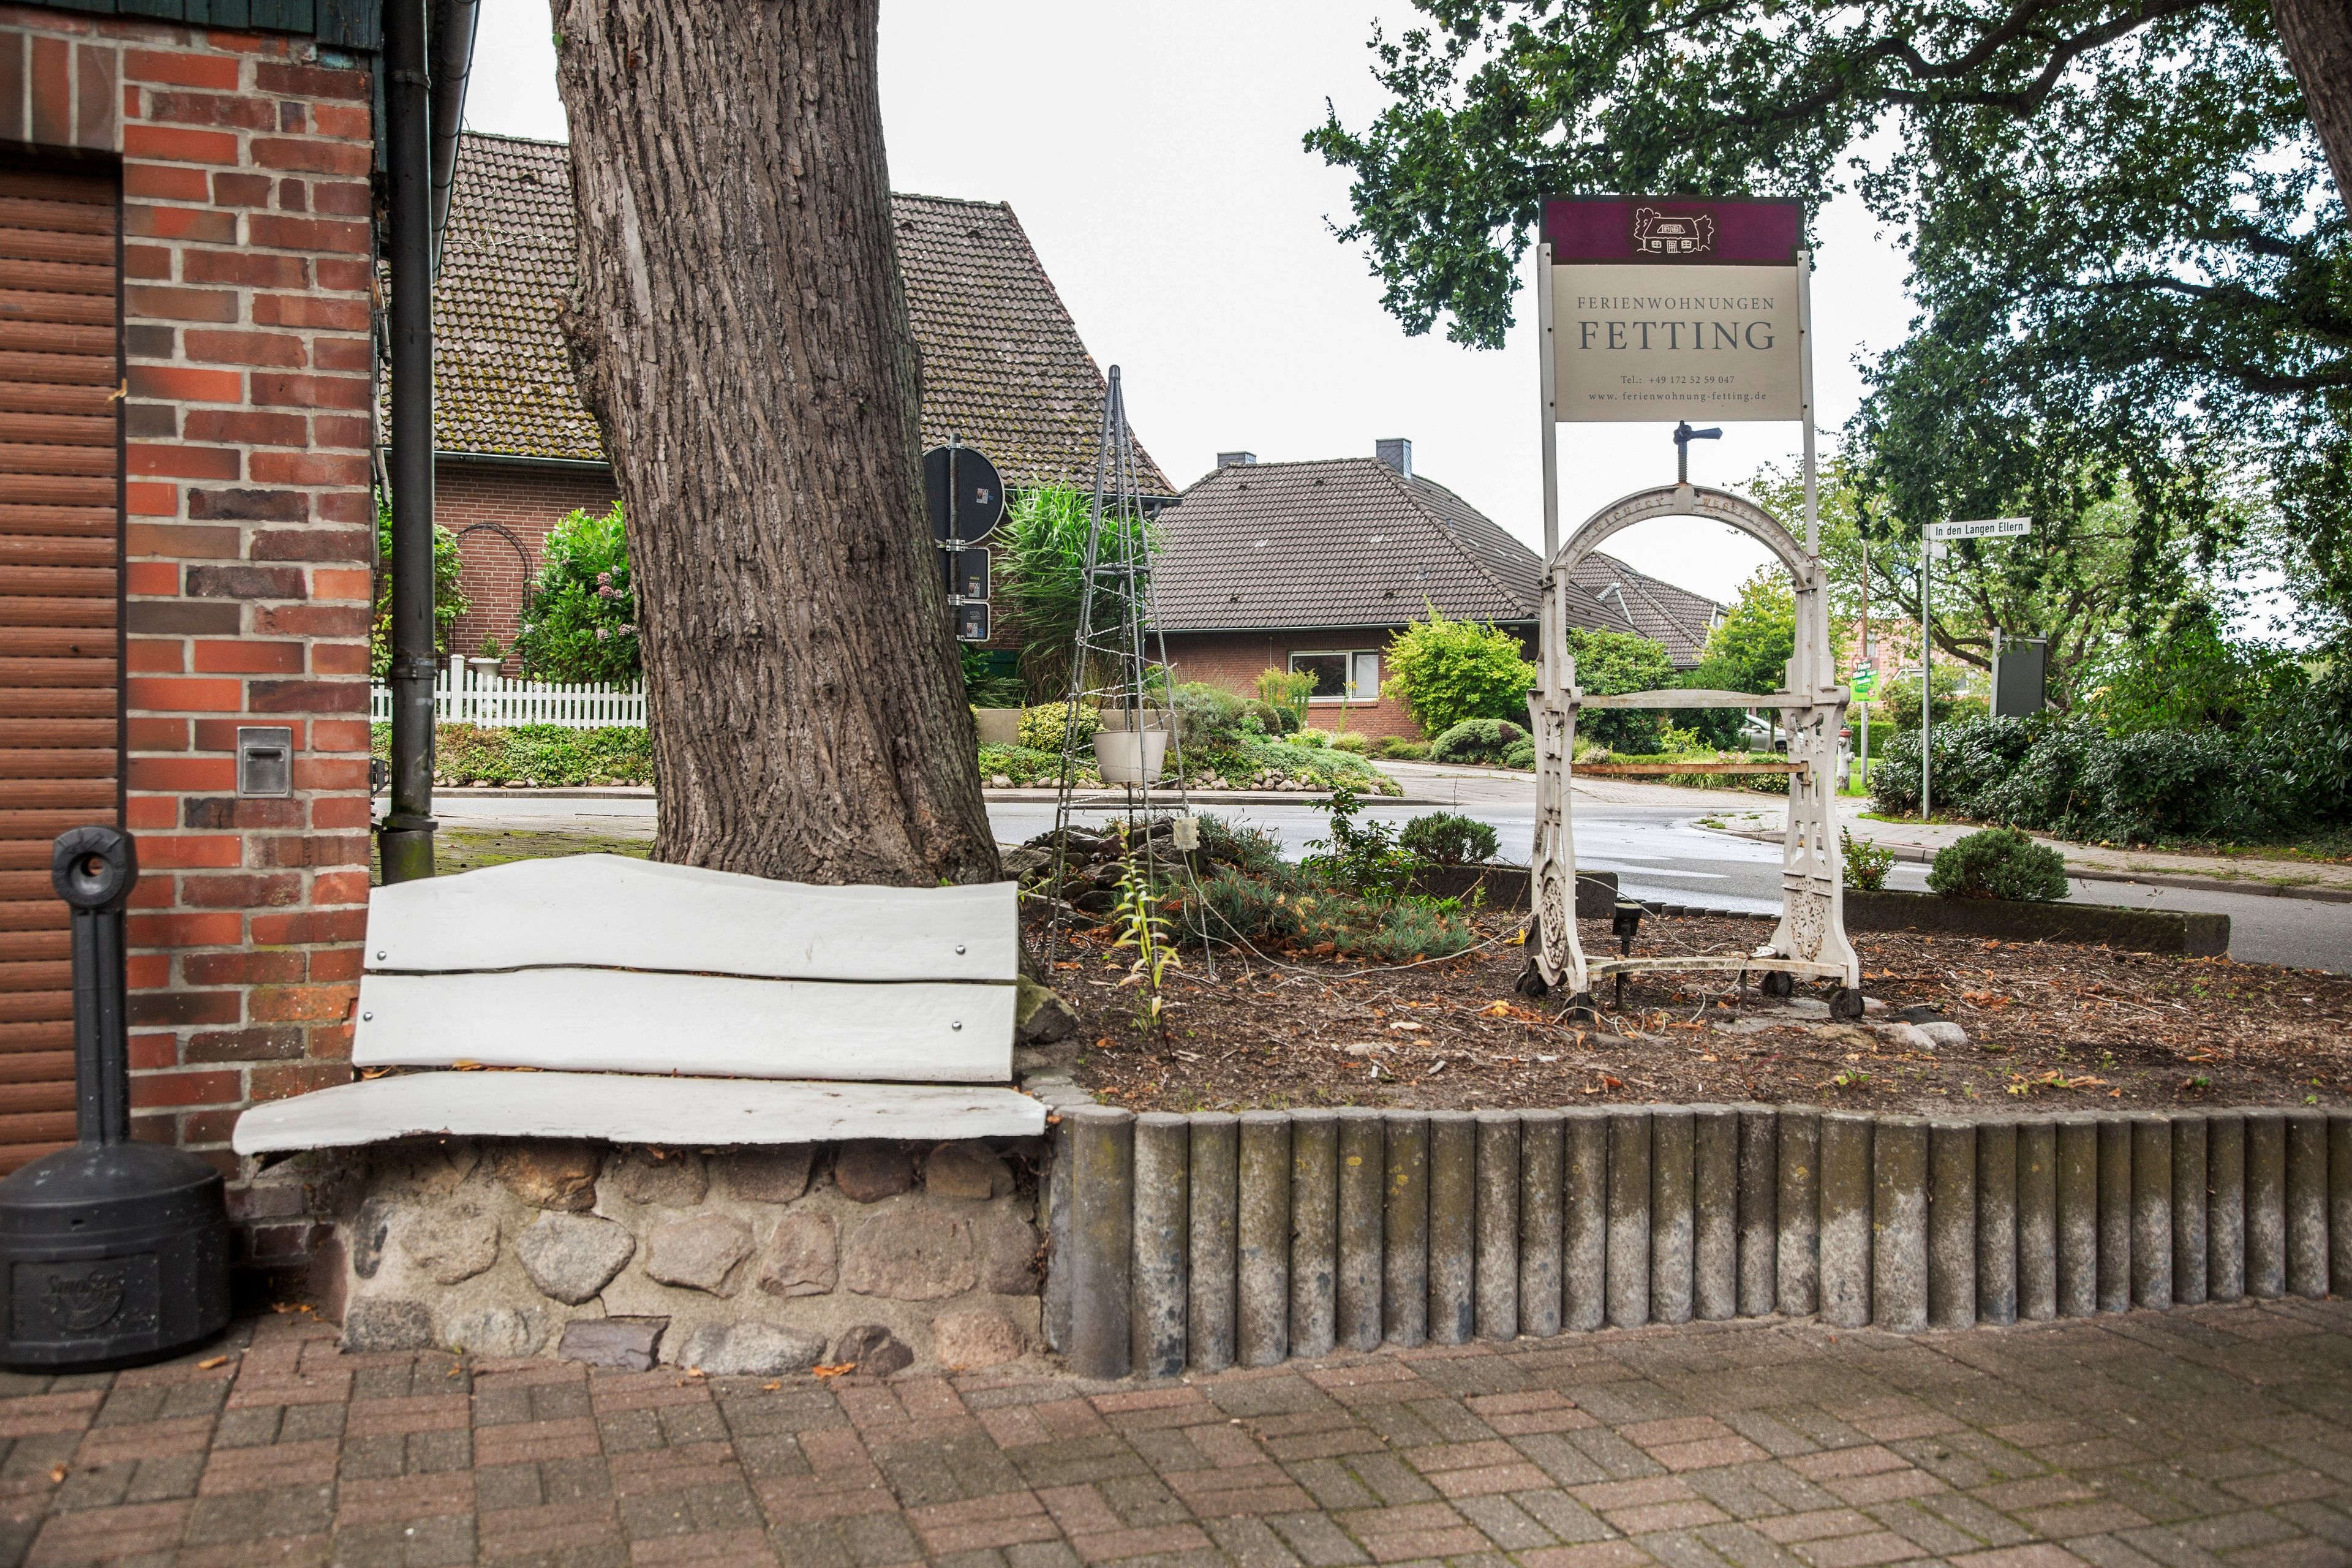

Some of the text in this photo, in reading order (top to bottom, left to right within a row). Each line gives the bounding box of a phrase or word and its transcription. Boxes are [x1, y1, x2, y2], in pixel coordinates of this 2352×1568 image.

[1577, 296, 1774, 310] FERIENWOHNUNGEN
[1578, 321, 1775, 350] FETTING
[1621, 375, 1735, 384] Tel.: +49 172 52 59 047
[1936, 522, 2023, 536] In den Langen Ellern
